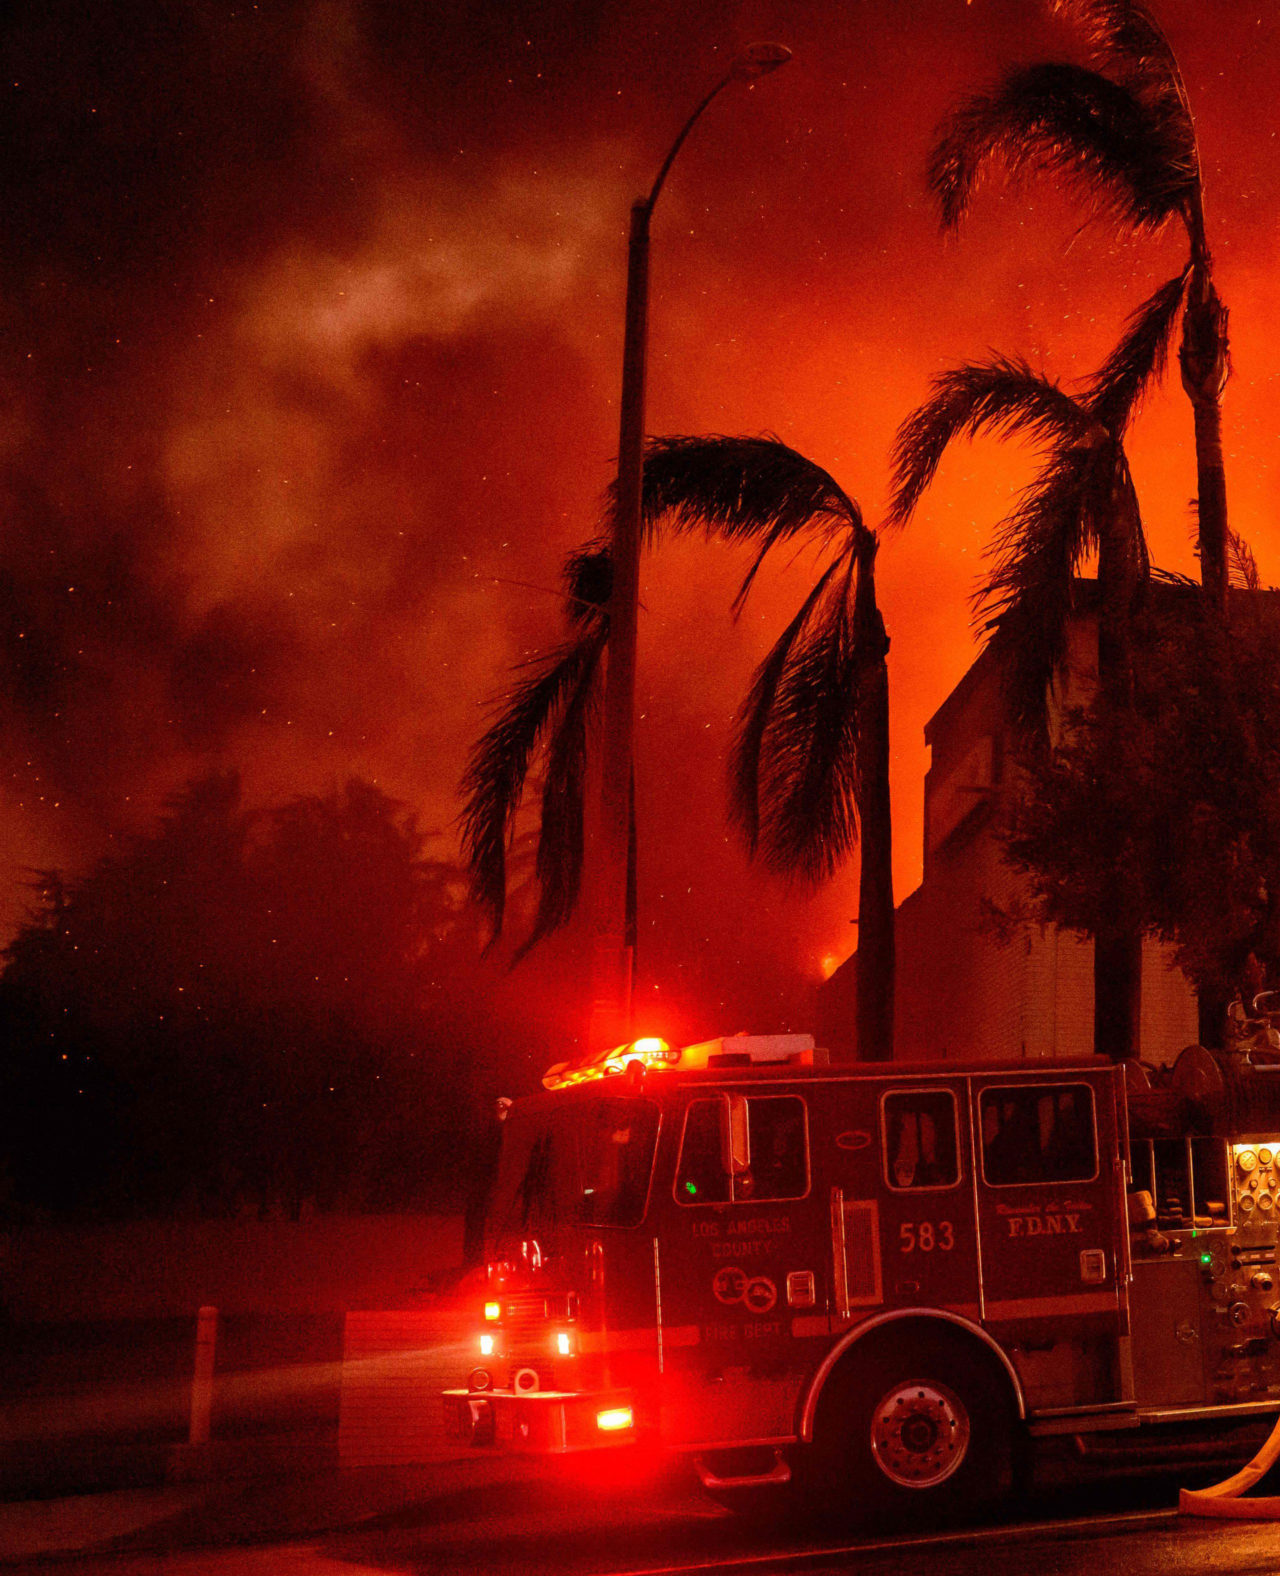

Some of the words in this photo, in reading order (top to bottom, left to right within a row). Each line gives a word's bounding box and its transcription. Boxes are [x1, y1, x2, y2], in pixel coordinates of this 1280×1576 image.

[692, 1220, 720, 1238] LOS
[727, 1216, 791, 1236] ANGELES
[900, 1220, 955, 1253] 583
[711, 1238, 773, 1258] COUNTY
